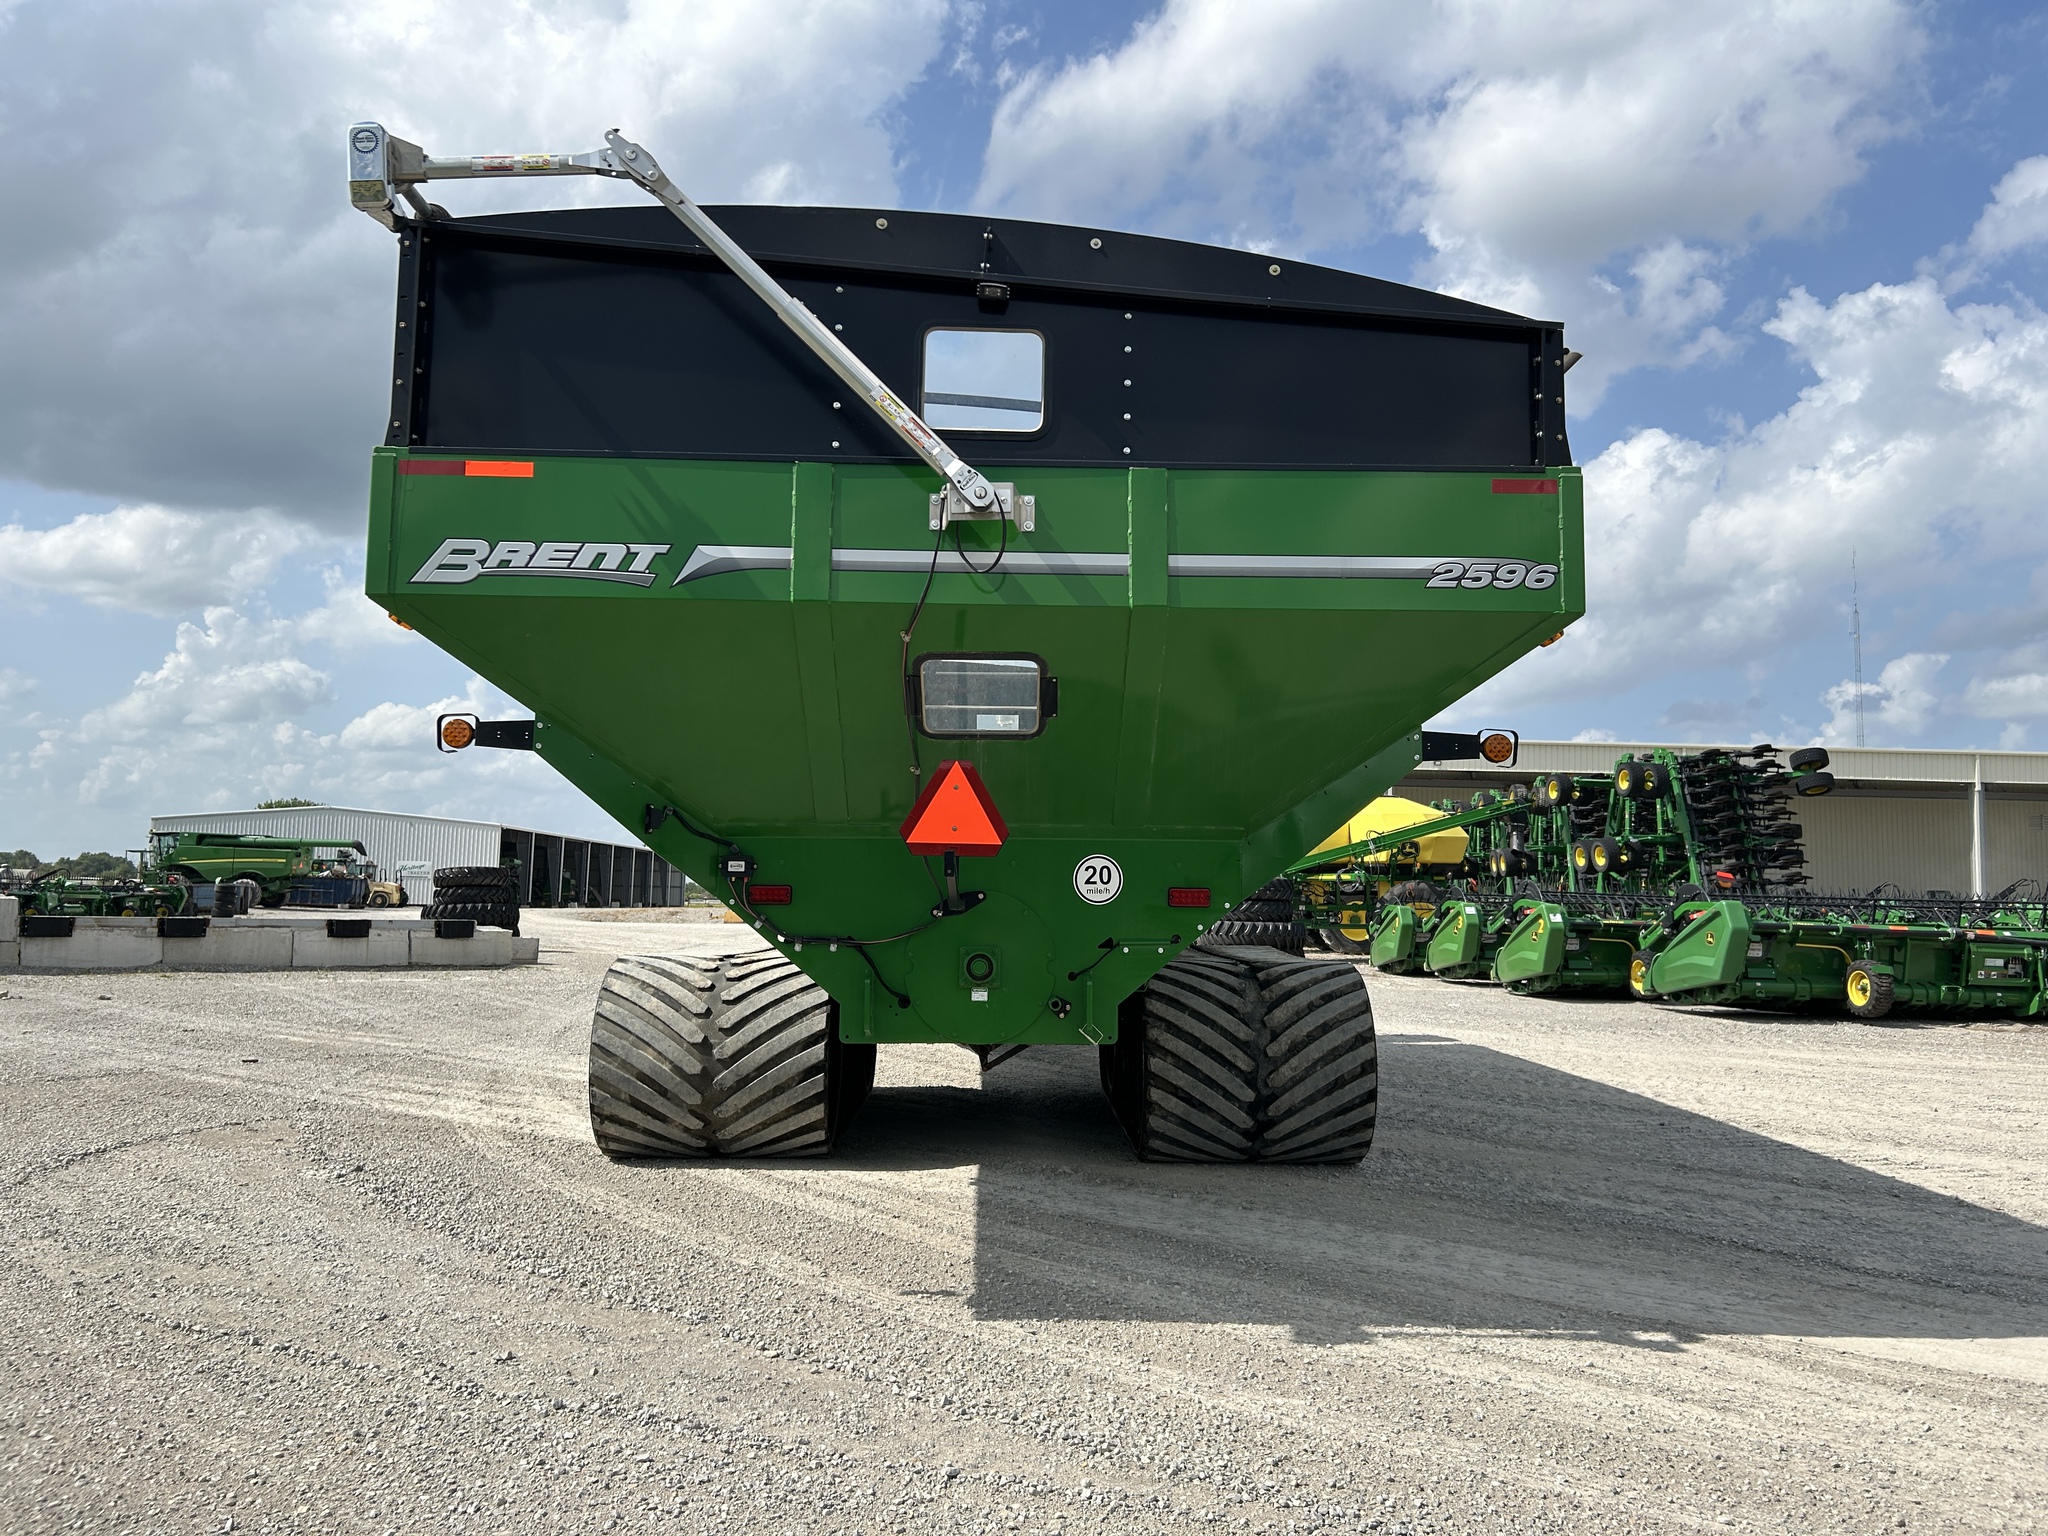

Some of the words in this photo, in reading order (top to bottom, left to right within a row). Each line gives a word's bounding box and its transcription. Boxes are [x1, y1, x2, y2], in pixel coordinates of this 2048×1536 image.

[1425, 562, 1559, 590] 2596
[1084, 865, 1112, 885] 20
[1086, 887, 1110, 895] mile/h
[1457, 915, 1463, 929] 3
[1538, 919, 1545, 934] 2
